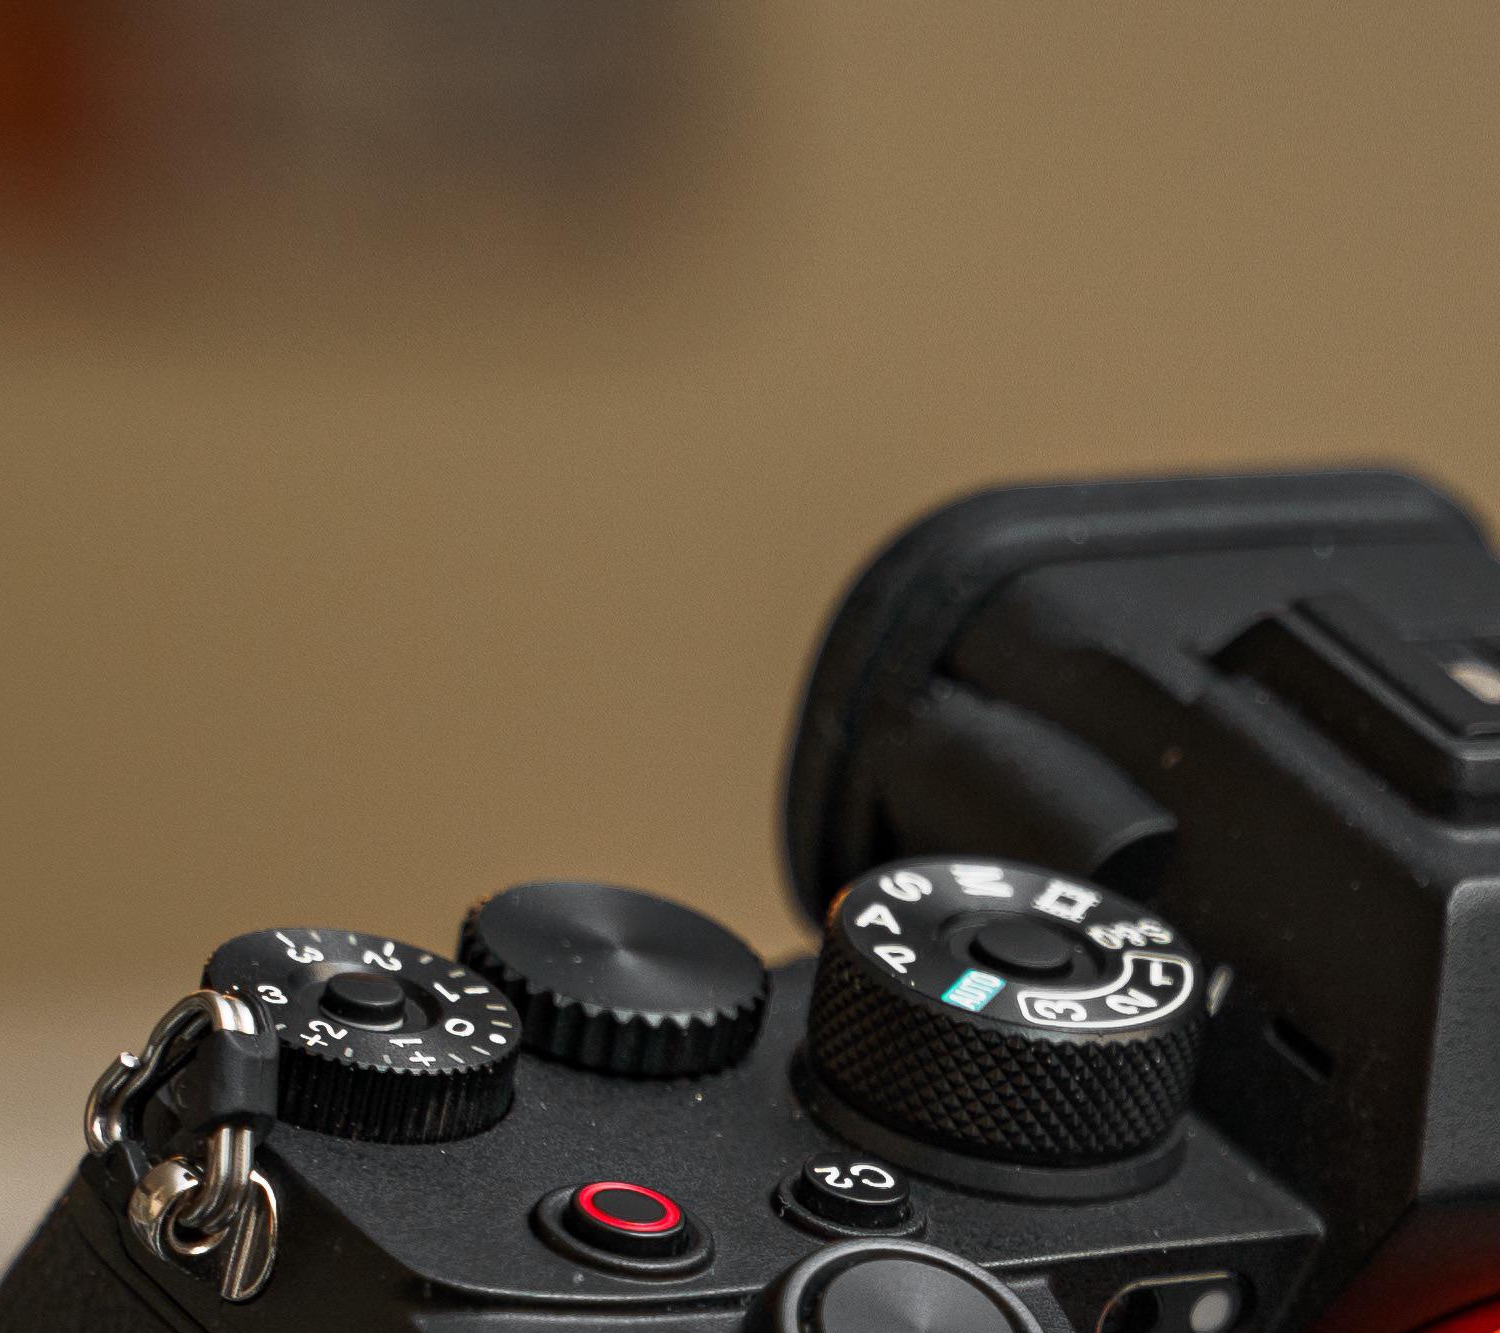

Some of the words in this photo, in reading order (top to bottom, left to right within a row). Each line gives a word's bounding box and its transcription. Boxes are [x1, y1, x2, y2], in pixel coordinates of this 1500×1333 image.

[878, 870, 933, 902] S
[854, 903, 902, 935] A
[873, 943, 917, 974] P
[1150, 960, 1174, 987] 1
[949, 968, 1002, 1013] AUTO
[1105, 986, 1159, 1016] 2
[1033, 999, 1088, 1023] 3
[813, 1163, 897, 1190] C2
